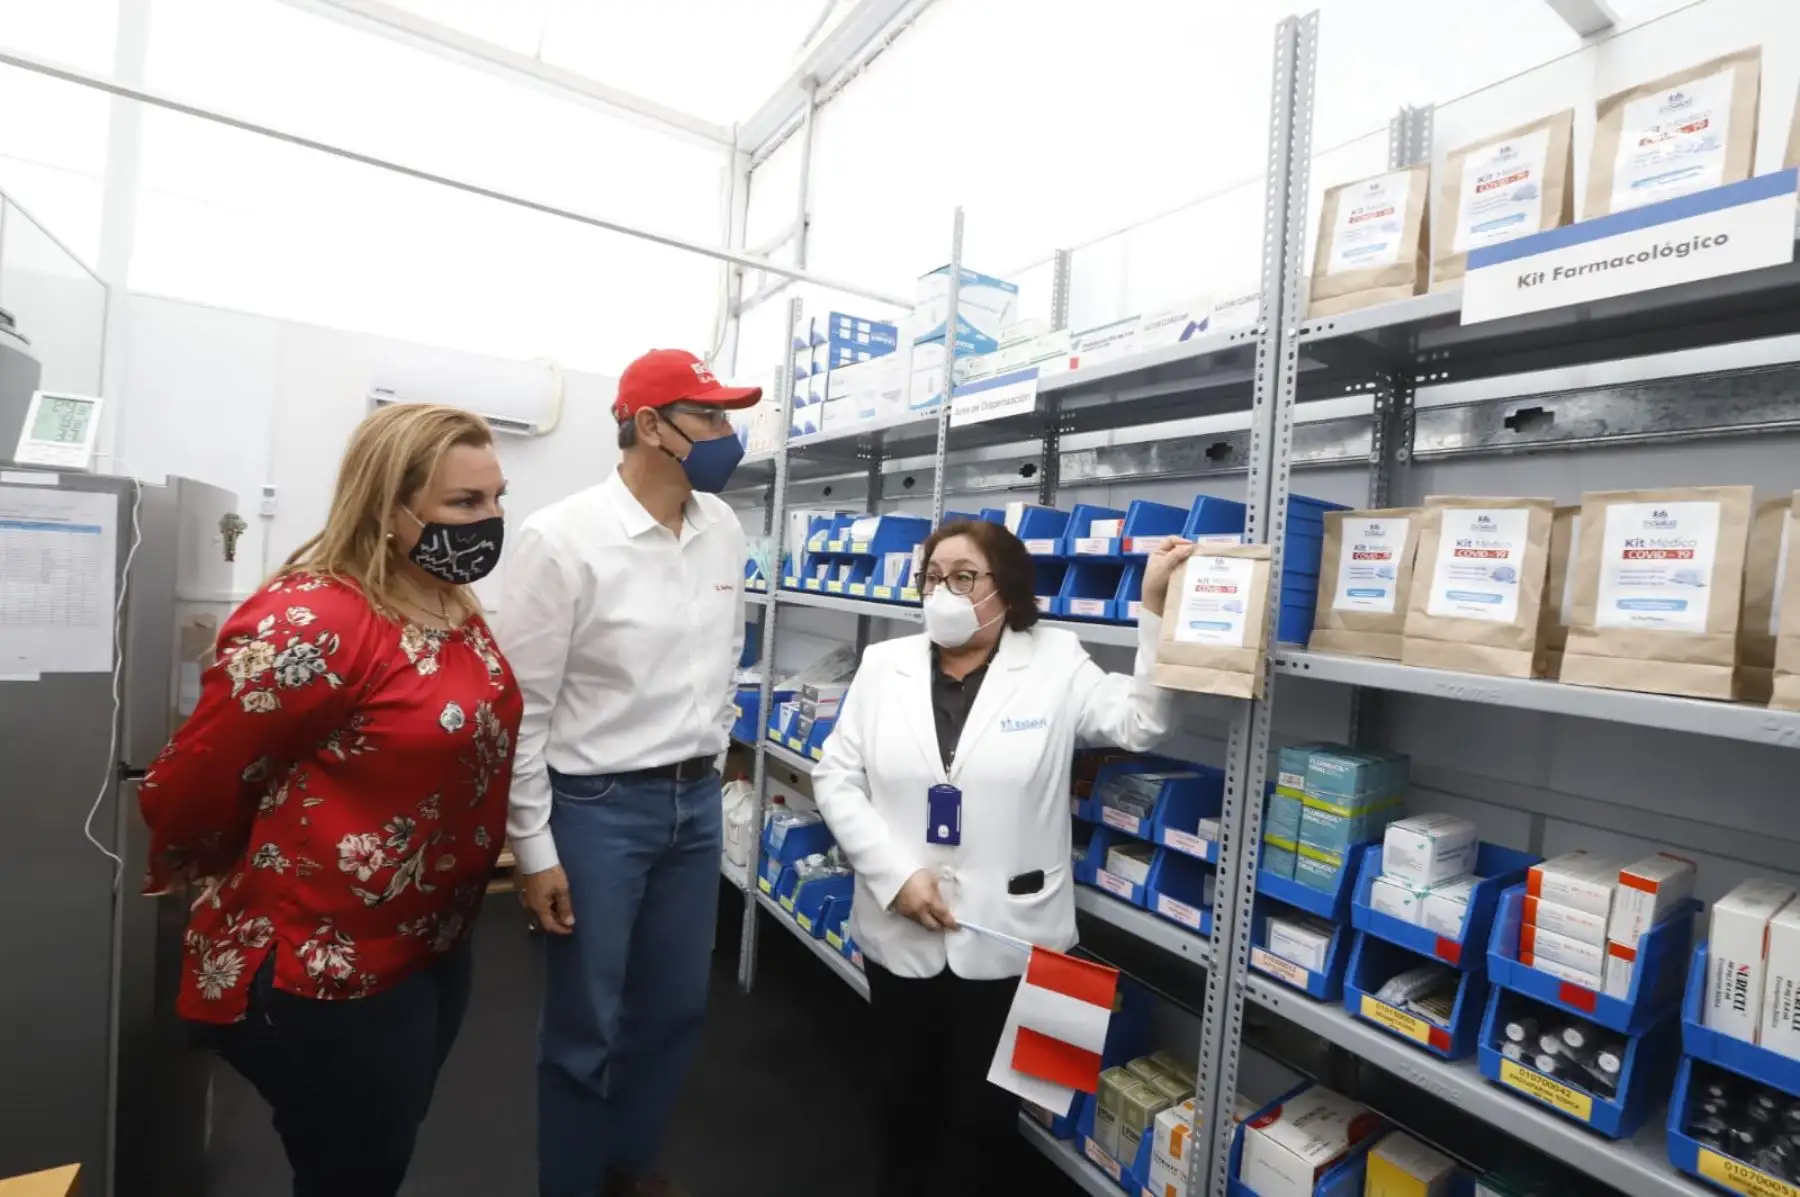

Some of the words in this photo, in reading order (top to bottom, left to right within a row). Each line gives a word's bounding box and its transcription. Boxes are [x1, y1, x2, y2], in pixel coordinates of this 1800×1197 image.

[1518, 272, 1546, 289] Kit
[1552, 233, 1729, 281] Farmacológico
[1456, 539, 1473, 549] Kit
[1625, 537, 1645, 548] Kit
